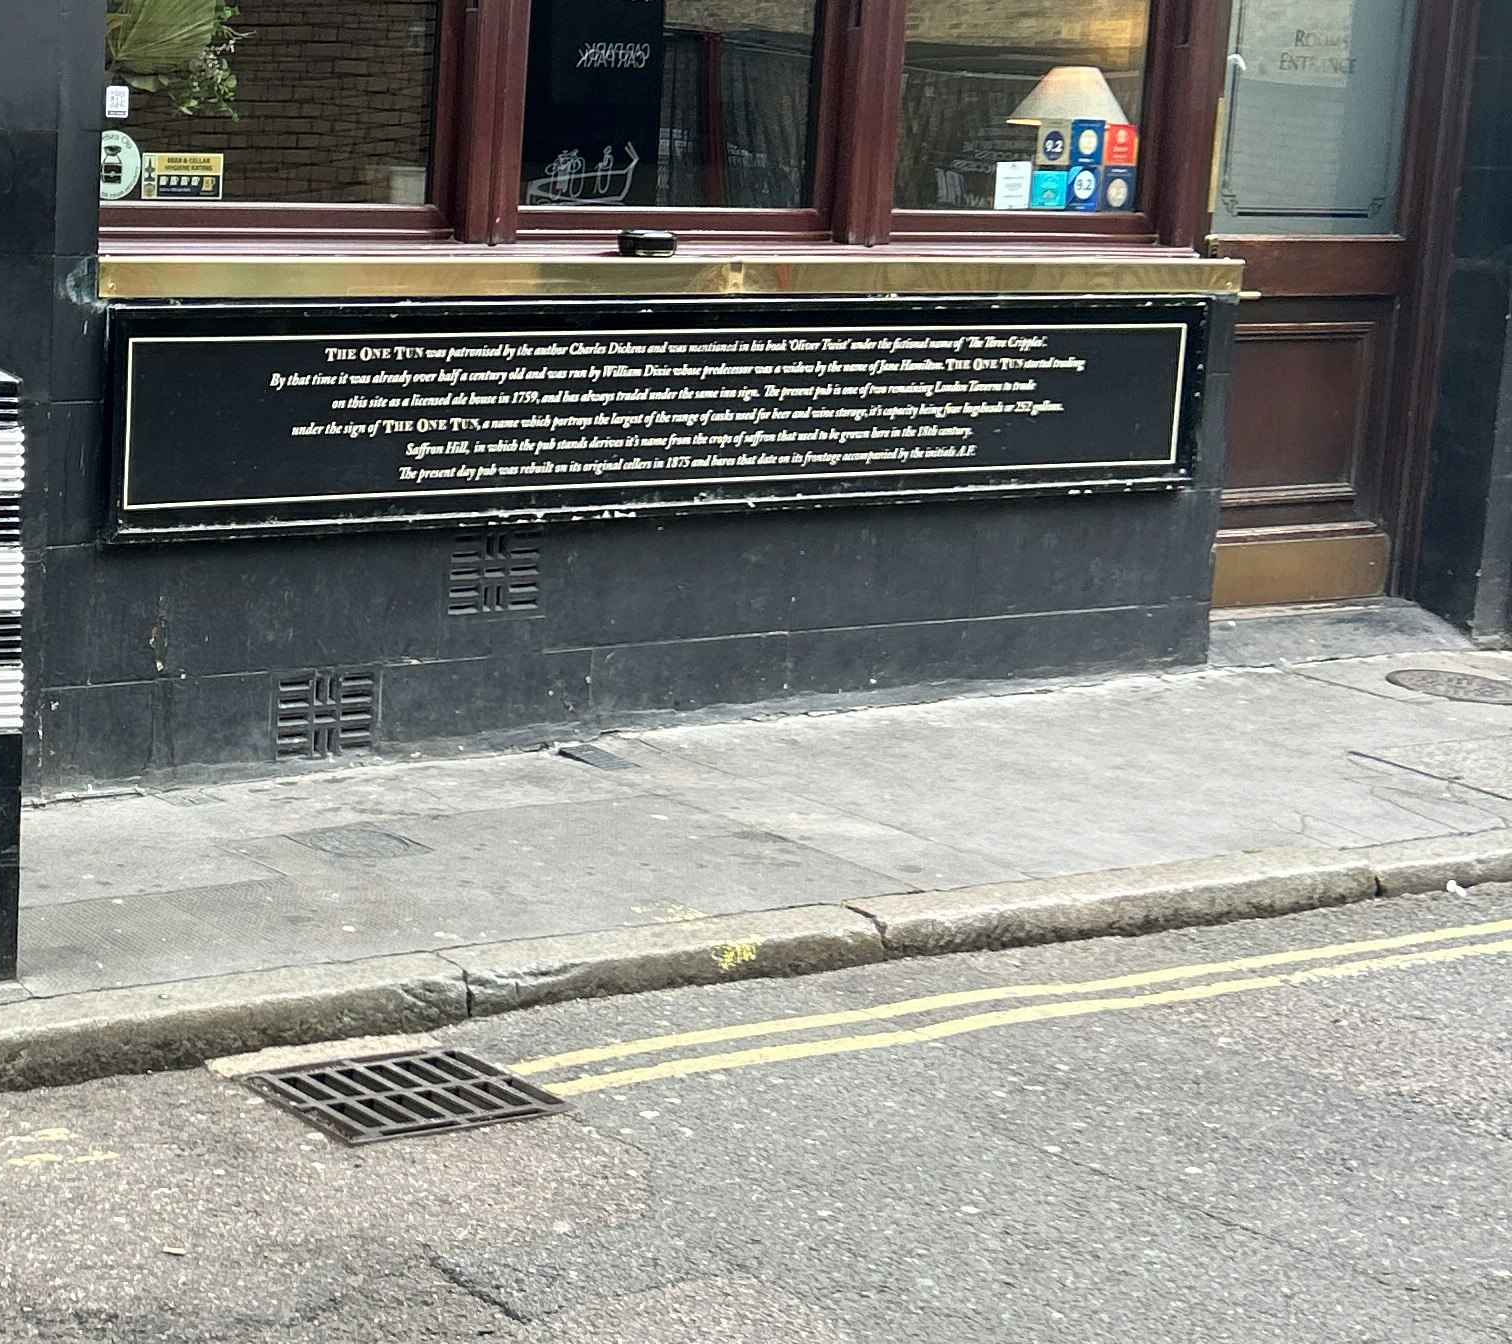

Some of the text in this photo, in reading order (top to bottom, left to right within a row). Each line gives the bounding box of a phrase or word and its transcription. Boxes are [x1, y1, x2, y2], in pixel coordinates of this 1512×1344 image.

[325, 348, 356, 361] THE
[360, 347, 391, 361] ONE
[394, 347, 424, 360] TUN
[425, 349, 446, 357] was
[446, 344, 501, 362] patronised
[503, 344, 516, 360] by
[517, 344, 533, 356] the
[534, 343, 568, 355] author
[569, 343, 606, 355] Charles
[608, 342, 645, 354] Dickens
[647, 341, 668, 353] and
[668, 345, 687, 353] was
[270, 373, 285, 390] By
[287, 373, 311, 385] that
[312, 373, 336, 385] time
[349, 375, 371, 384] was
[372, 370, 411, 387] already
[413, 374, 436, 382] over
[437, 369, 462, 385] half
[469, 371, 508, 384] century
[509, 368, 523, 380] old
[526, 367, 546, 379] and
[569, 370, 587, 378] run
[603, 365, 642, 377] William
[672, 364, 701, 375] whose
[347, 396, 367, 408] this
[369, 396, 388, 407] site
[411, 393, 451, 406] licensed
[452, 393, 467, 405] ale
[469, 392, 496, 404] house
[541, 391, 563, 403] and
[580, 390, 615, 405] always
[616, 388, 648, 401] traded
[649, 388, 677, 400] under
[292, 422, 323, 435] under
[325, 422, 342, 434] the
[343, 425, 366, 438] sign
[368, 420, 382, 437] of
[383, 420, 413, 433] THE
[416, 419, 446, 432] ONE
[491, 420, 519, 428] name
[521, 415, 551, 427] which
[550, 416, 593, 431] portrays
[611, 413, 643, 428] largest
[672, 414, 699, 426] range
[406, 442, 443, 459] Saffron
[487, 439, 518, 452] which
[519, 439, 535, 451] the
[535, 438, 555, 455] pub
[557, 437, 587, 449] stands
[641, 438, 666, 446] name
[665, 433, 692, 449] from
[399, 467, 416, 479] The
[417, 468, 455, 483] present
[457, 465, 476, 481] day
[476, 464, 496, 480] pub
[497, 467, 518, 475] was
[520, 461, 553, 473] rebuilt
[569, 461, 582, 472] its
[583, 458, 622, 475] original
[666, 456, 691, 468] 1875
